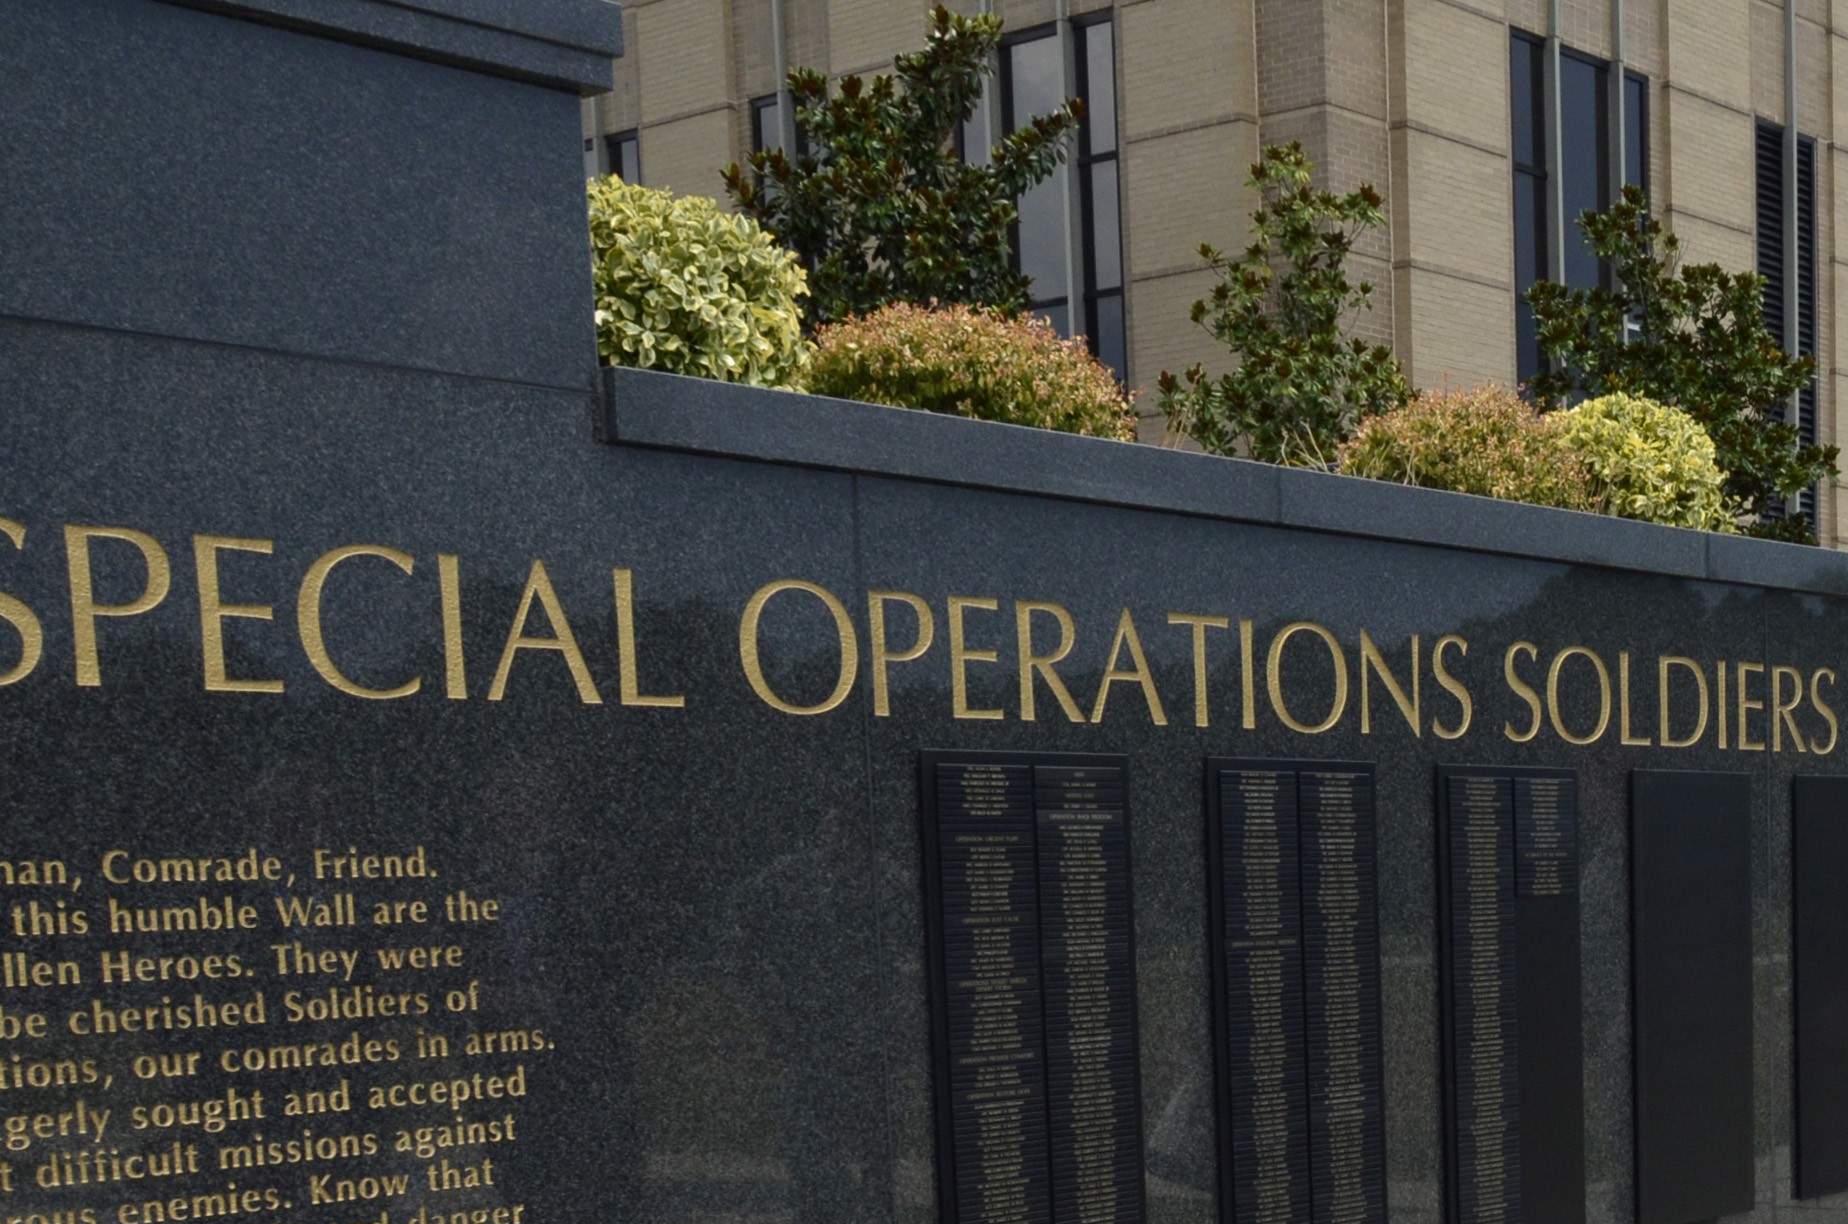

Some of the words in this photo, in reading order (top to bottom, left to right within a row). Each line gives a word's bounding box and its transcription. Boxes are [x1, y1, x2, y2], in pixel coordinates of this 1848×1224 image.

[0, 517, 686, 708] SPECIAL
[738, 579, 1473, 740] OPERATIONS
[1504, 640, 1839, 755] SOLDIERS
[0, 859, 82, 891] an,
[101, 847, 296, 886] Comrade,
[313, 845, 438, 880] Friend.
[11, 899, 89, 938] this
[108, 895, 258, 934] humble
[275, 892, 356, 928] Wall
[373, 900, 428, 926] are
[445, 890, 499, 923] the
[2, 951, 82, 989] llen
[100, 950, 255, 984] Heroes.
[271, 940, 358, 982] They
[377, 946, 463, 971] were
[68, 991, 267, 1036] cherished
[283, 984, 430, 1023] Soldiers
[445, 979, 479, 1013] of
[0, 1053, 114, 1091] tions,
[132, 1051, 201, 1080] our
[220, 1031, 401, 1073] comrades
[416, 1027, 450, 1060] in
[464, 1029, 556, 1056] arms.
[4, 1099, 110, 1152] gerly
[130, 1087, 264, 1133] sought
[283, 1078, 351, 1117] and
[368, 1064, 527, 1112] accepted
[35, 1140, 199, 1189] difficult
[219, 1128, 379, 1170] missions
[394, 1113, 516, 1160] against
[309, 1174, 409, 1206] Know
[427, 1158, 494, 1192] that
